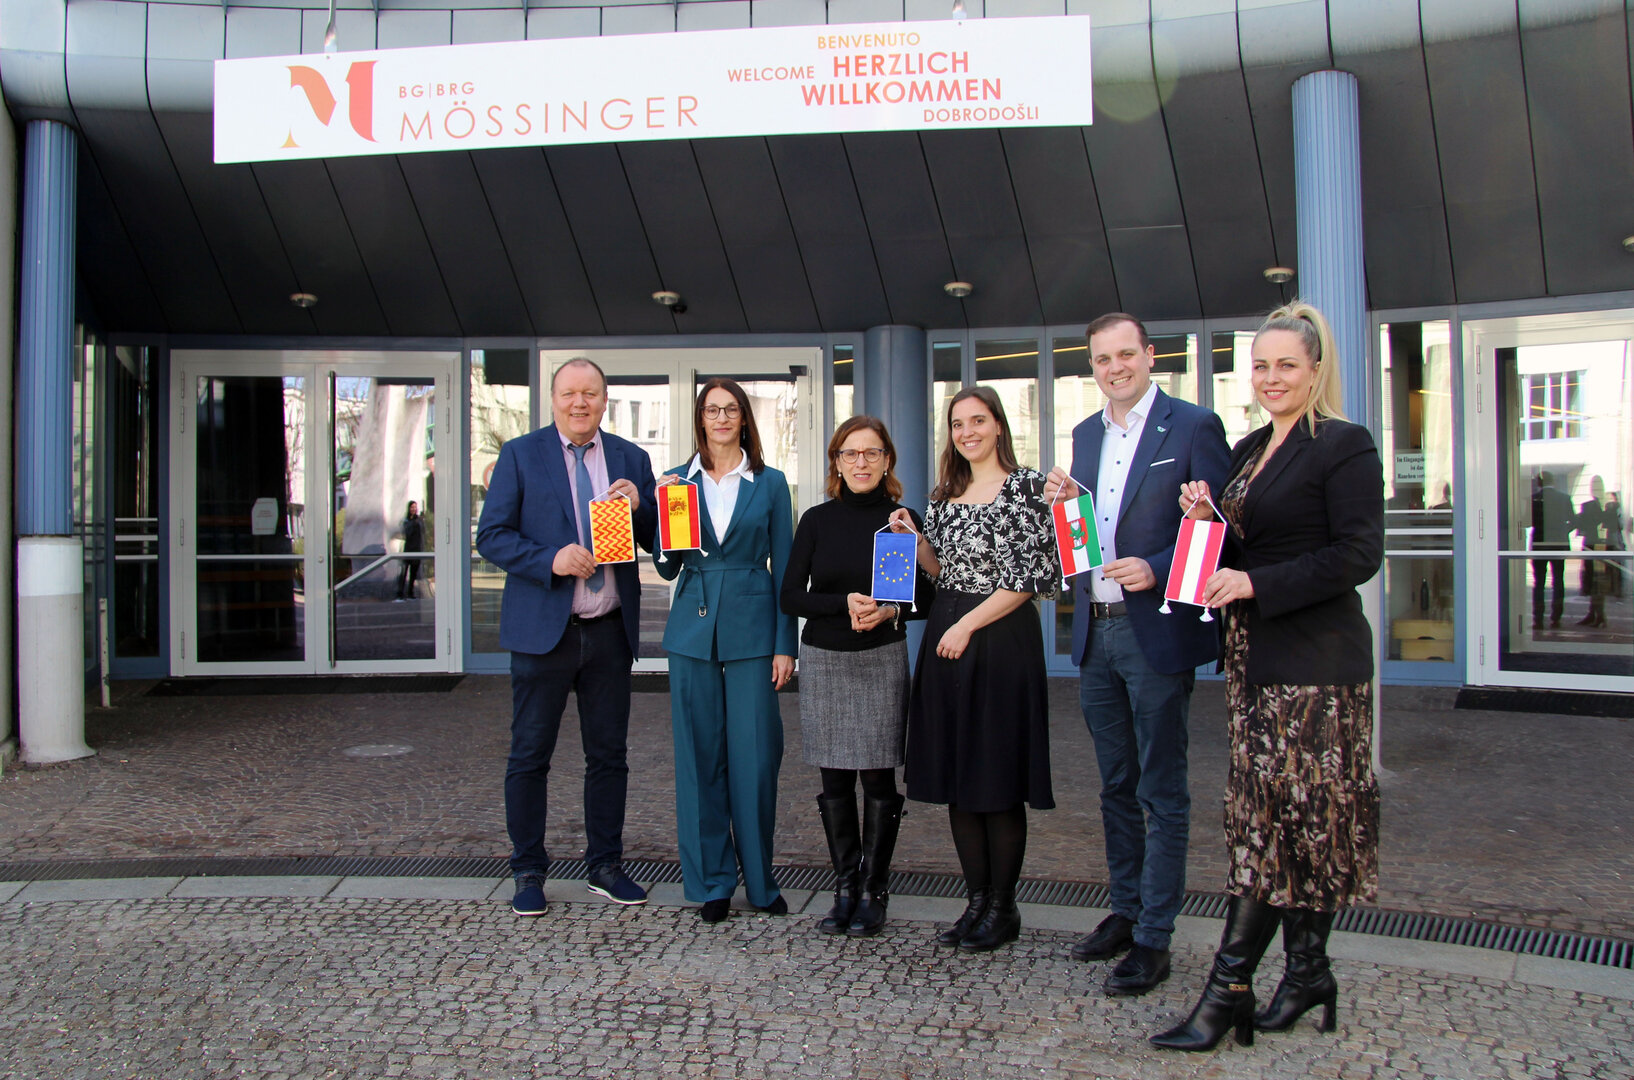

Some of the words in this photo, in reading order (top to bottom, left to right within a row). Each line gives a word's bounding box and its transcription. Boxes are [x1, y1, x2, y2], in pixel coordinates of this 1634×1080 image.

[817, 31, 921, 49] BENVENUTO
[727, 65, 815, 83] WELCOME
[833, 51, 969, 79] HERZLICH
[800, 77, 1002, 107] WILLKOMMEN
[399, 94, 699, 142] MÖSSINGER
[923, 103, 1040, 123] DOBRODOŠLI
